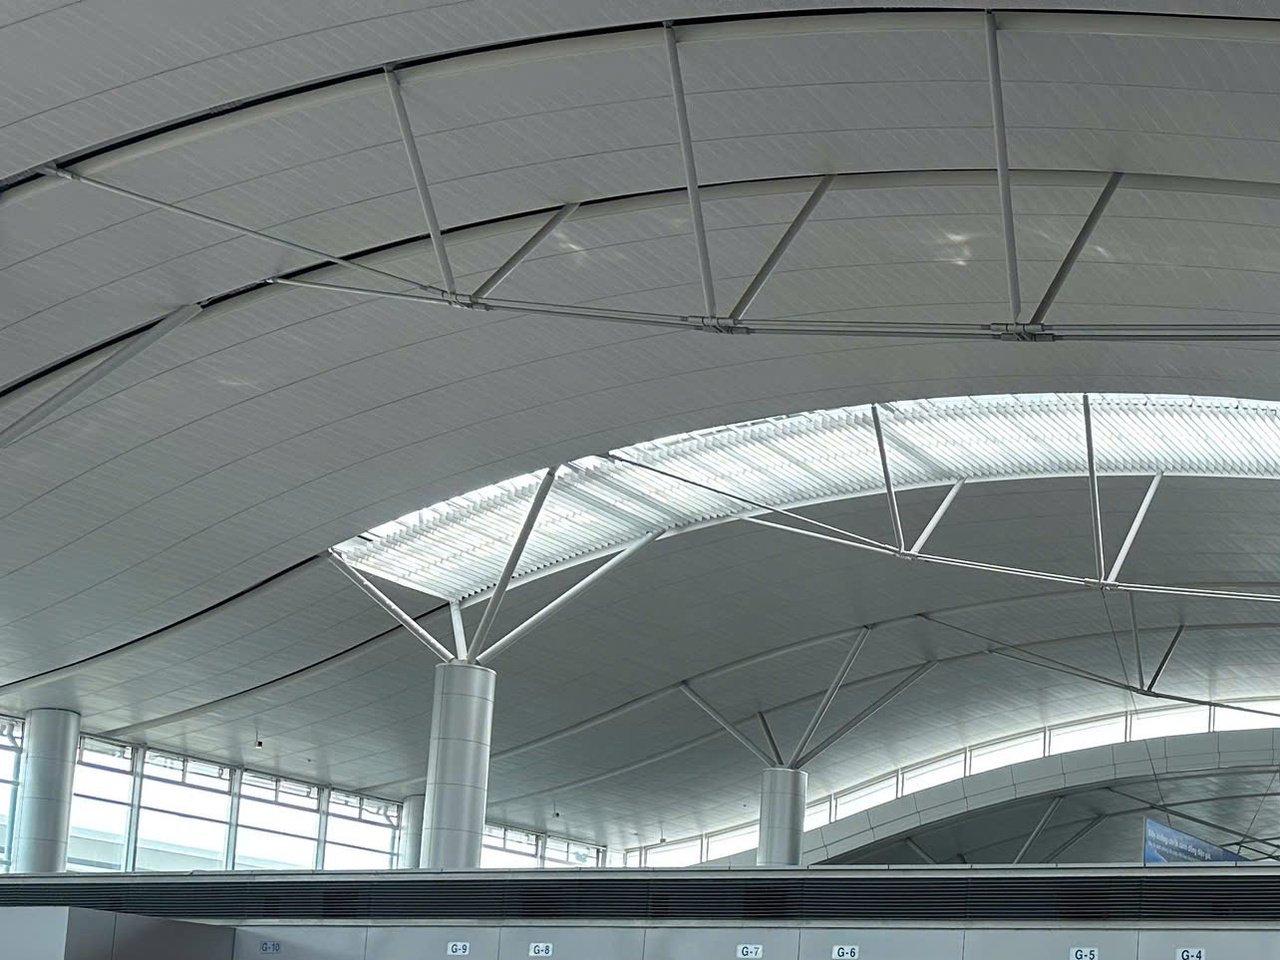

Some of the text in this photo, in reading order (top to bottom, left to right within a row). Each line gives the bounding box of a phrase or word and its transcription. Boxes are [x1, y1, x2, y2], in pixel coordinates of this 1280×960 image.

[261, 942, 280, 952] G-10
[451, 944, 467, 953] G-9
[533, 945, 550, 954] G-8
[741, 946, 759, 956] G-7
[837, 947, 856, 957] G-6
[1075, 949, 1095, 960] G-5
[1181, 950, 1202, 960] G-4
